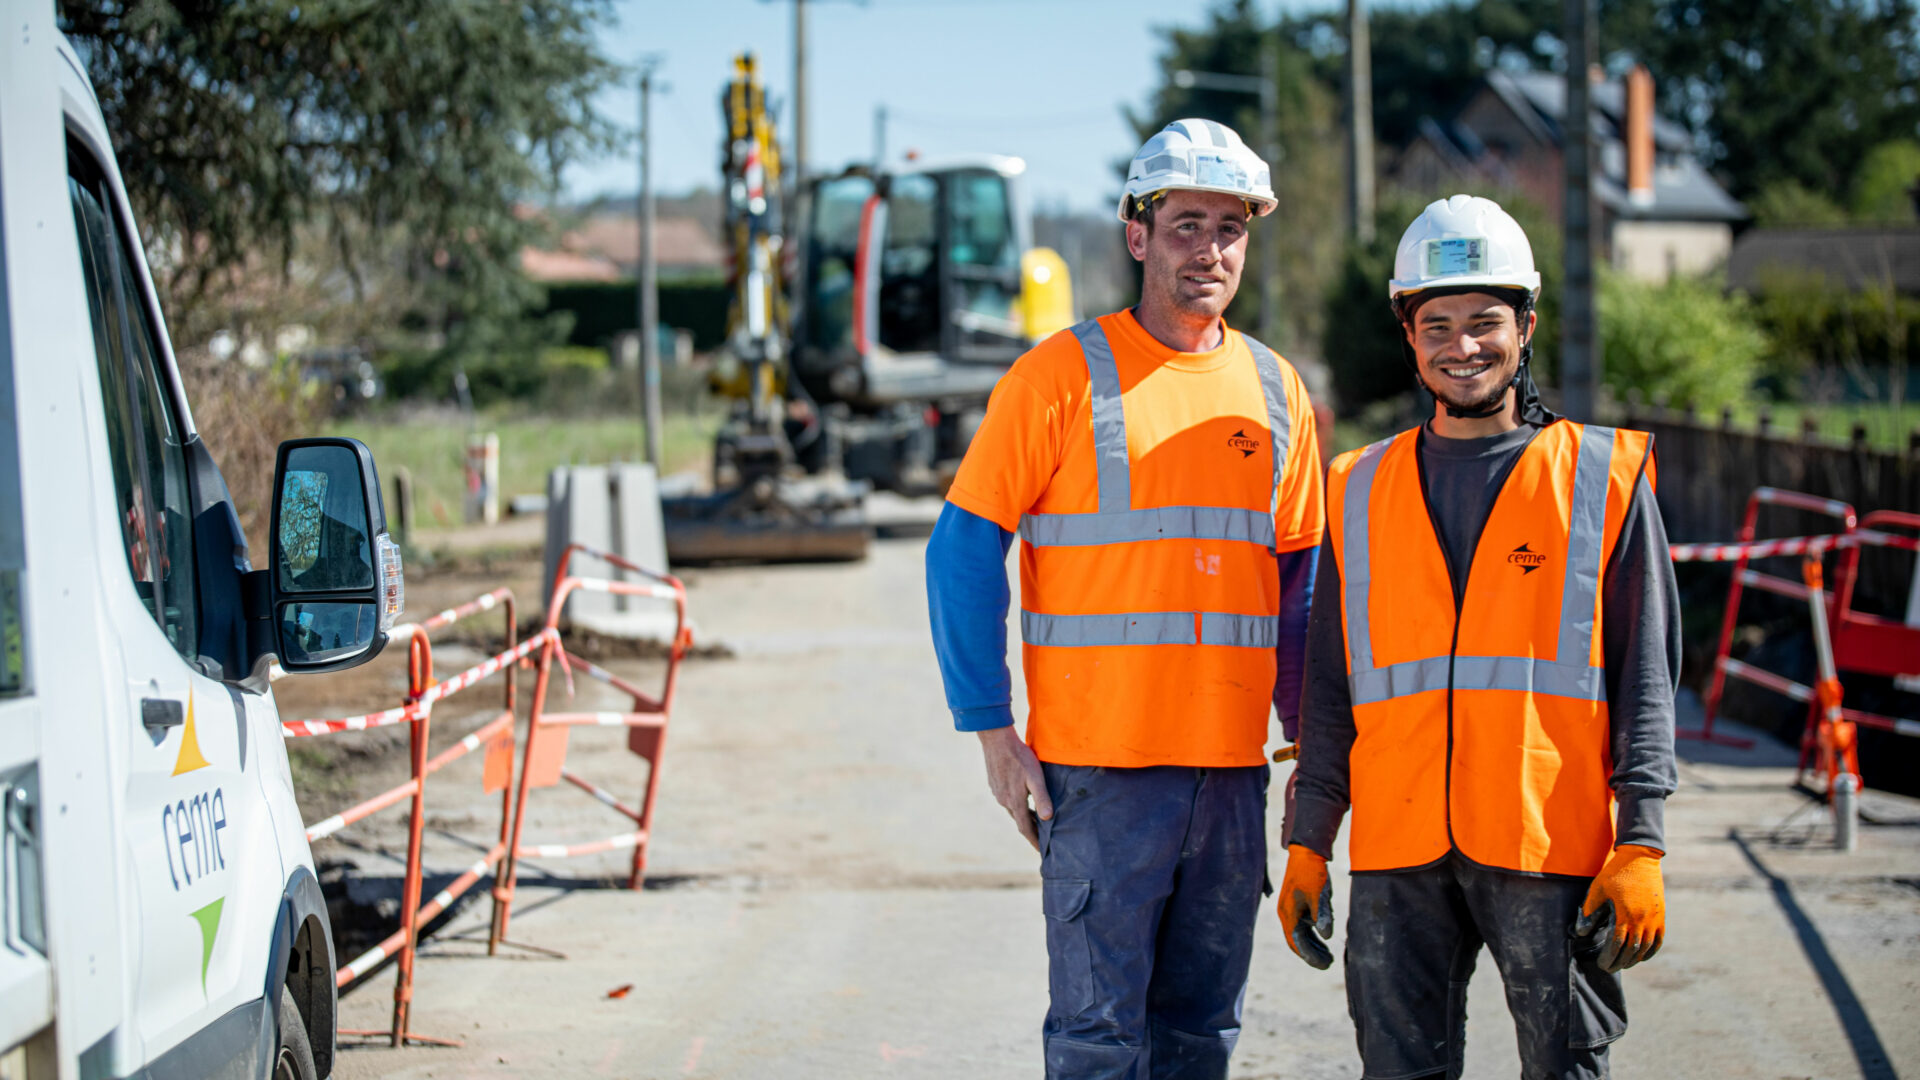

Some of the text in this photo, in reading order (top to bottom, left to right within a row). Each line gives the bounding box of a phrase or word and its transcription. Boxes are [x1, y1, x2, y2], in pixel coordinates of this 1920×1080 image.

[1227, 438, 1260, 449] ceme
[1507, 553, 1546, 564] ceme
[162, 787, 227, 891] ceme
